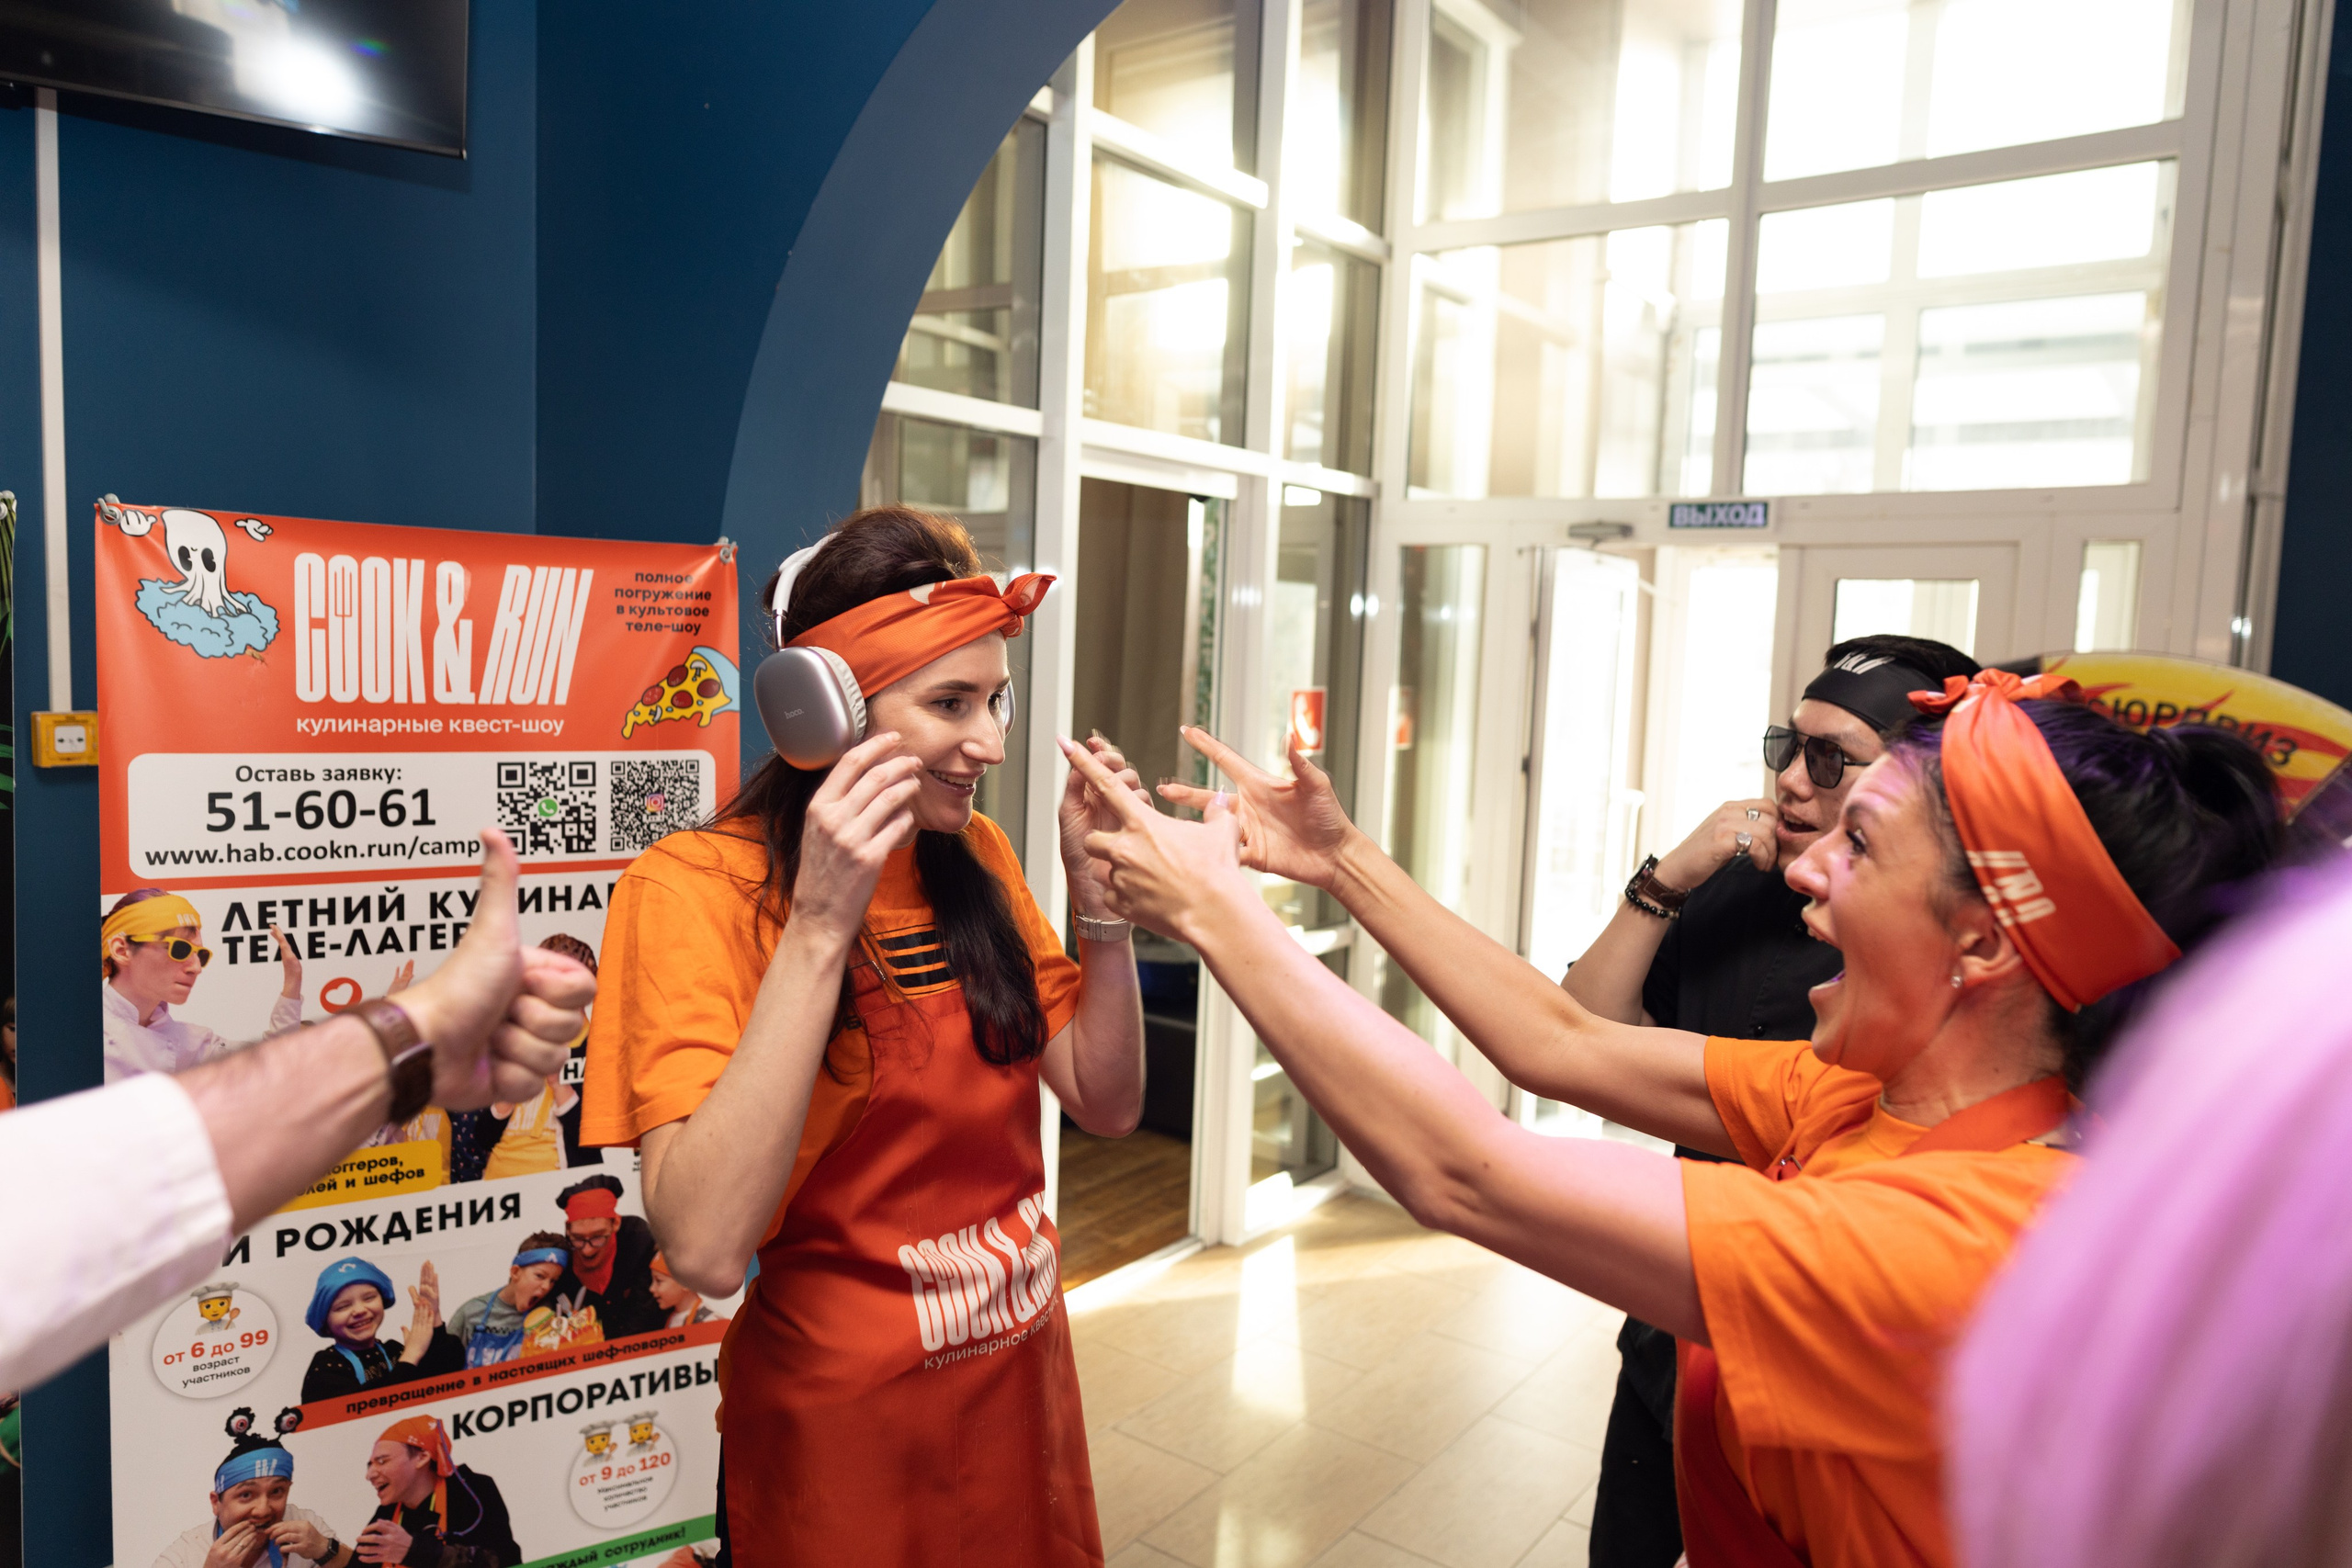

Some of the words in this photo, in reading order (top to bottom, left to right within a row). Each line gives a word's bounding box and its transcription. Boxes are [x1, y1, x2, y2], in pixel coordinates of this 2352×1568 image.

[1674, 503, 1764, 526] ВЫХОД
[635, 571, 694, 584] полное
[615, 587, 712, 602] погружение
[616, 604, 625, 615] в
[629, 604, 709, 617] культовое
[294, 552, 426, 705] COOK
[478, 564, 594, 705] RUN
[626, 621, 701, 636] теле-шоу
[296, 716, 444, 737] кулинарные
[449, 717, 564, 737] квест-шоу
[235, 764, 315, 782] Оставь
[322, 766, 402, 784] заявку:
[206, 788, 436, 832] 51-60-61
[145, 835, 481, 866] www.hab.cookn.run/camp
[221, 886, 405, 932] ЛЕТНИЙ
[429, 882, 616, 919] КУИНА
[345, 1179, 356, 1189] и
[364, 1168, 424, 1186] шефов
[276, 1192, 521, 1258] РОЖДЕНИЯ
[164, 1352, 185, 1365] от
[190, 1341, 205, 1358] 6
[210, 1342, 234, 1358] до
[240, 1329, 269, 1348] 99
[924, 1329, 1028, 1370] кулинарное
[182, 1367, 251, 1388] участников
[193, 1356, 240, 1372] возраст
[346, 1379, 466, 1414] превращение
[473, 1376, 481, 1385] в
[489, 1356, 576, 1382] настоящих
[582, 1334, 685, 1362] шеф-поваров
[453, 1358, 719, 1440] КОРПОРАТИВЫ
[579, 1473, 596, 1486] от
[601, 1466, 613, 1481] 9
[616, 1463, 635, 1479] до
[639, 1452, 671, 1472] 120
[604, 1526, 686, 1559] сотрудник!
